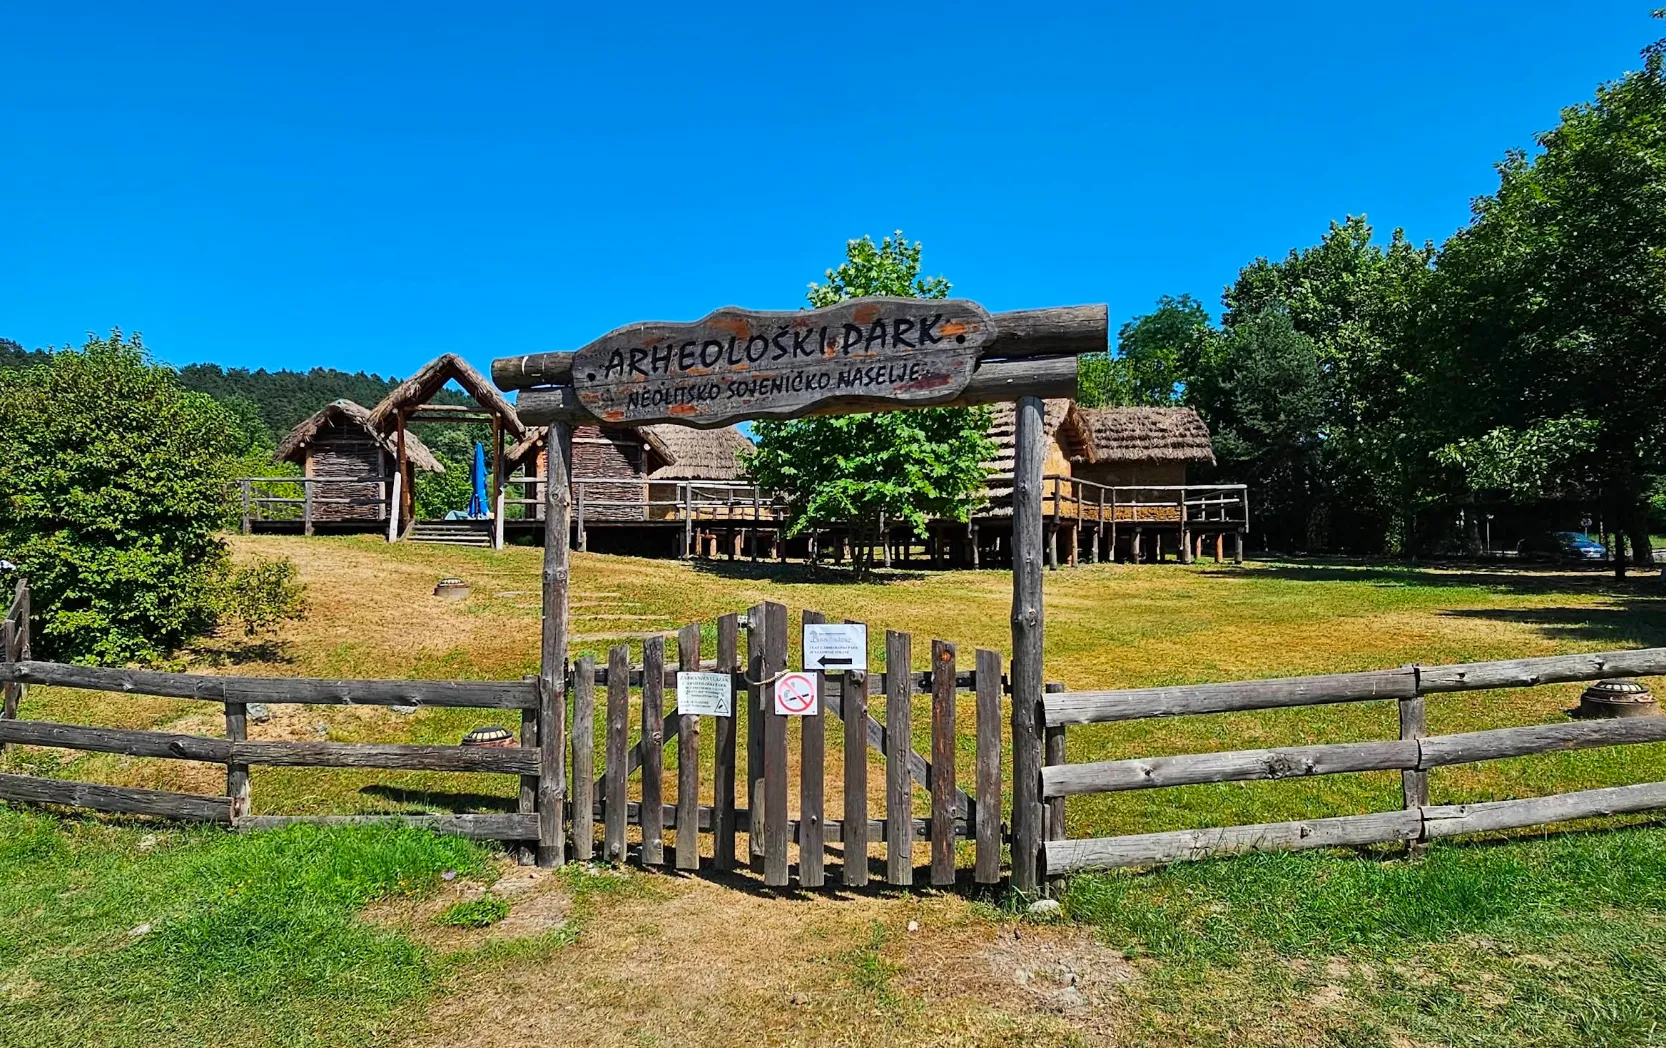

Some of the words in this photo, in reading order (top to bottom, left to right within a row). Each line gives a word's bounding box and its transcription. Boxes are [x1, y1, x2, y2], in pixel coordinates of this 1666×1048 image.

[604, 324, 828, 379] ARHEOLOŠKI
[842, 314, 943, 355] PARK
[627, 381, 720, 410] NEOLITSKO
[726, 367, 830, 400] SOJENIČKO
[837, 362, 921, 388] NASELJE
